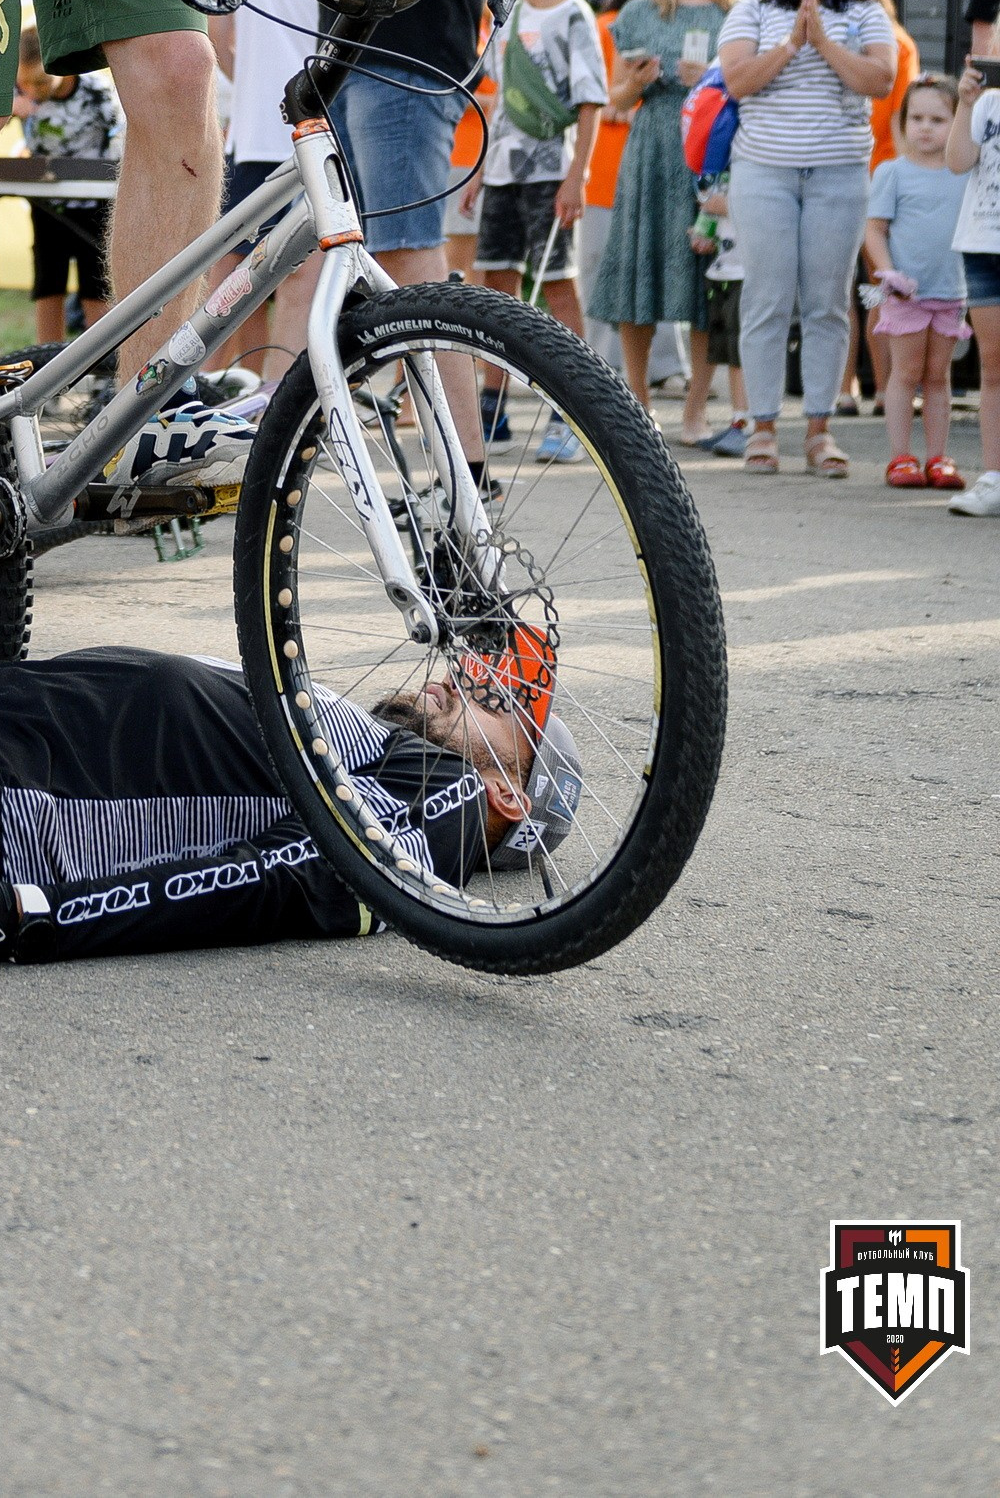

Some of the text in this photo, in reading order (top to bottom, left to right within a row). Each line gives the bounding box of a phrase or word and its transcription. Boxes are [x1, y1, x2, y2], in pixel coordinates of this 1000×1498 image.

[374, 319, 432, 337] MICHELIN
[434, 319, 473, 339] Country
[165, 861, 260, 900] YOKO
[57, 882, 150, 925] YOKO
